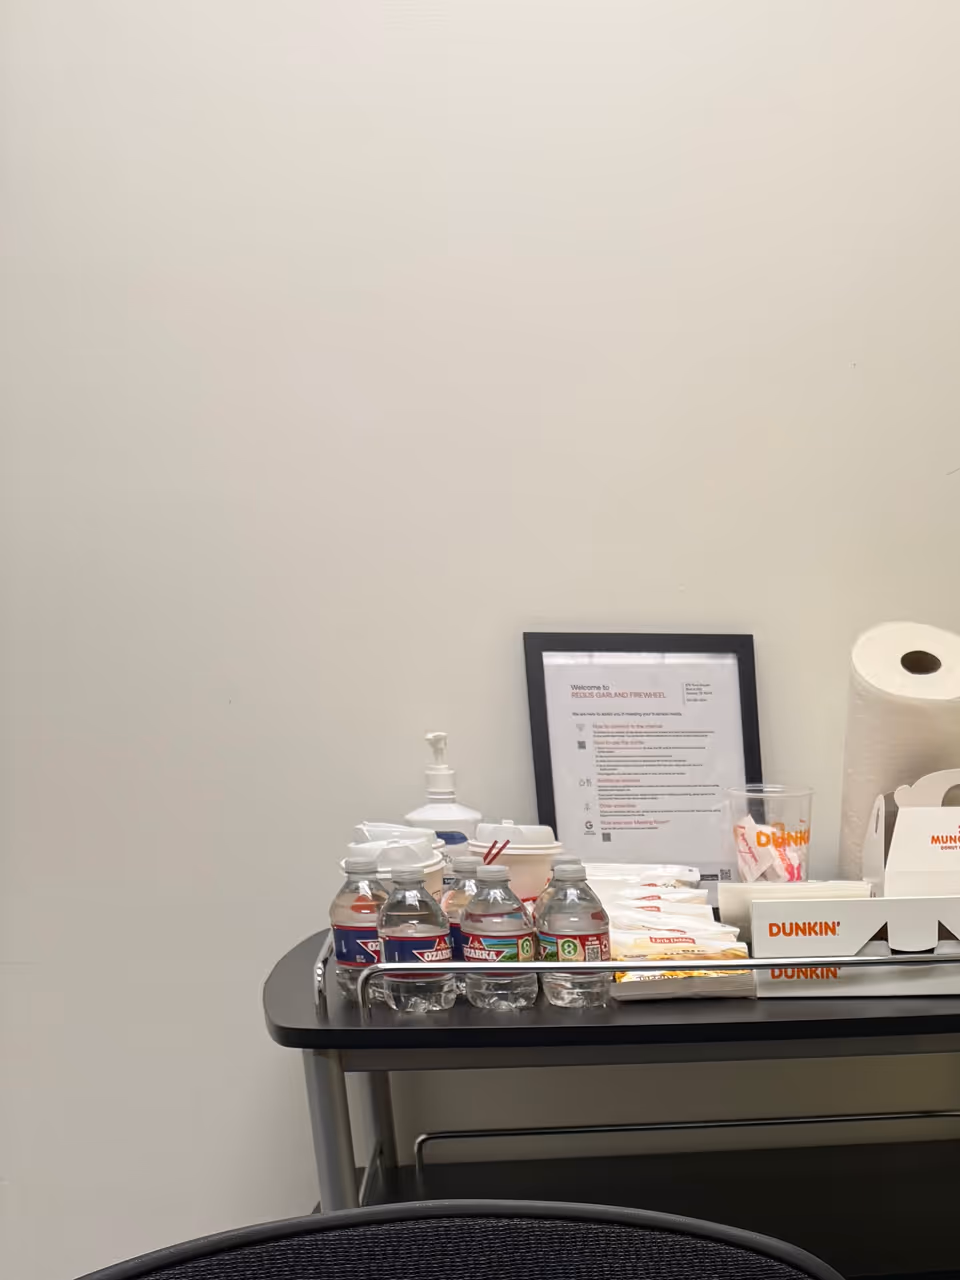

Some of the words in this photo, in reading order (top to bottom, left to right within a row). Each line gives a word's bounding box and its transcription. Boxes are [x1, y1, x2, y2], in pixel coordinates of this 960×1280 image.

[595, 691, 629, 699] GARLAND
[630, 691, 667, 699] FIREWHEEL
[768, 921, 840, 937] DUNKIN'
[770, 967, 841, 980] DUNKIN'
